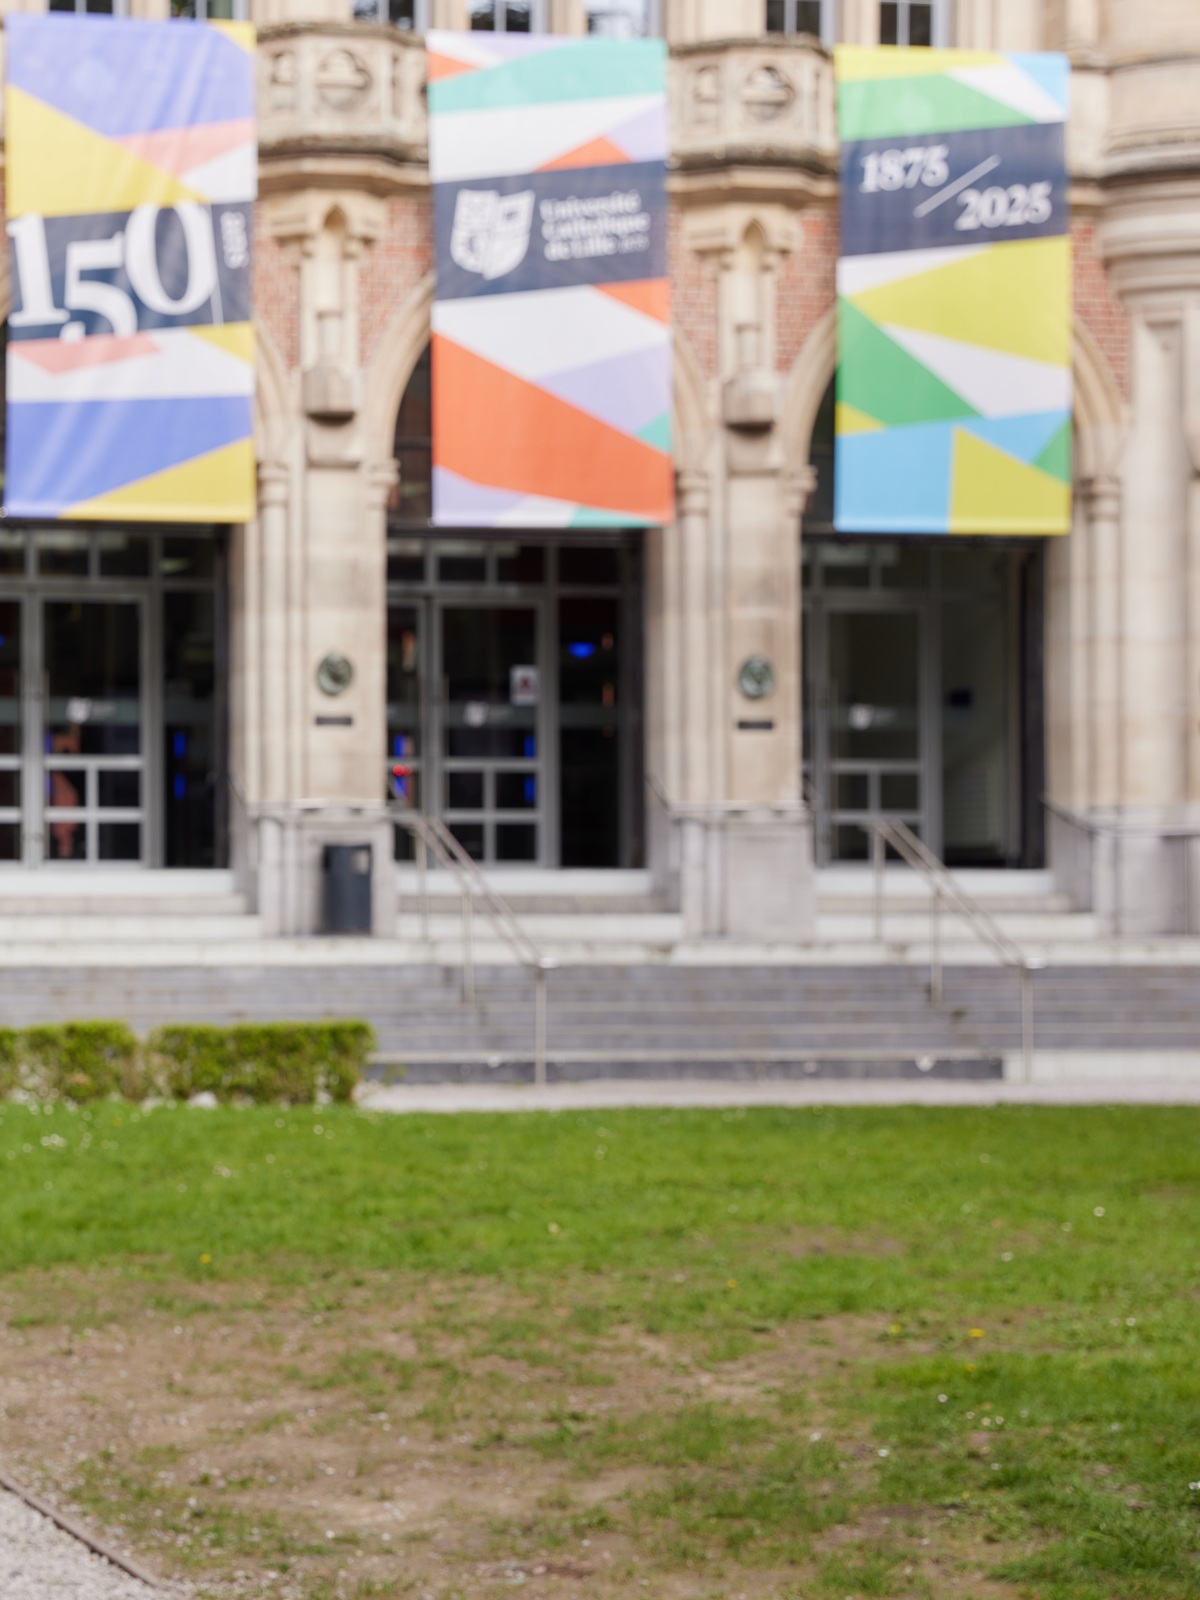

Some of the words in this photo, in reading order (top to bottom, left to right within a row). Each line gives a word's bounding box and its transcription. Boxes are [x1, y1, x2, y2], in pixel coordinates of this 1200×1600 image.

[861, 146, 947, 191] 1875
[956, 182, 1050, 229] 2025
[7, 201, 217, 342] 150
